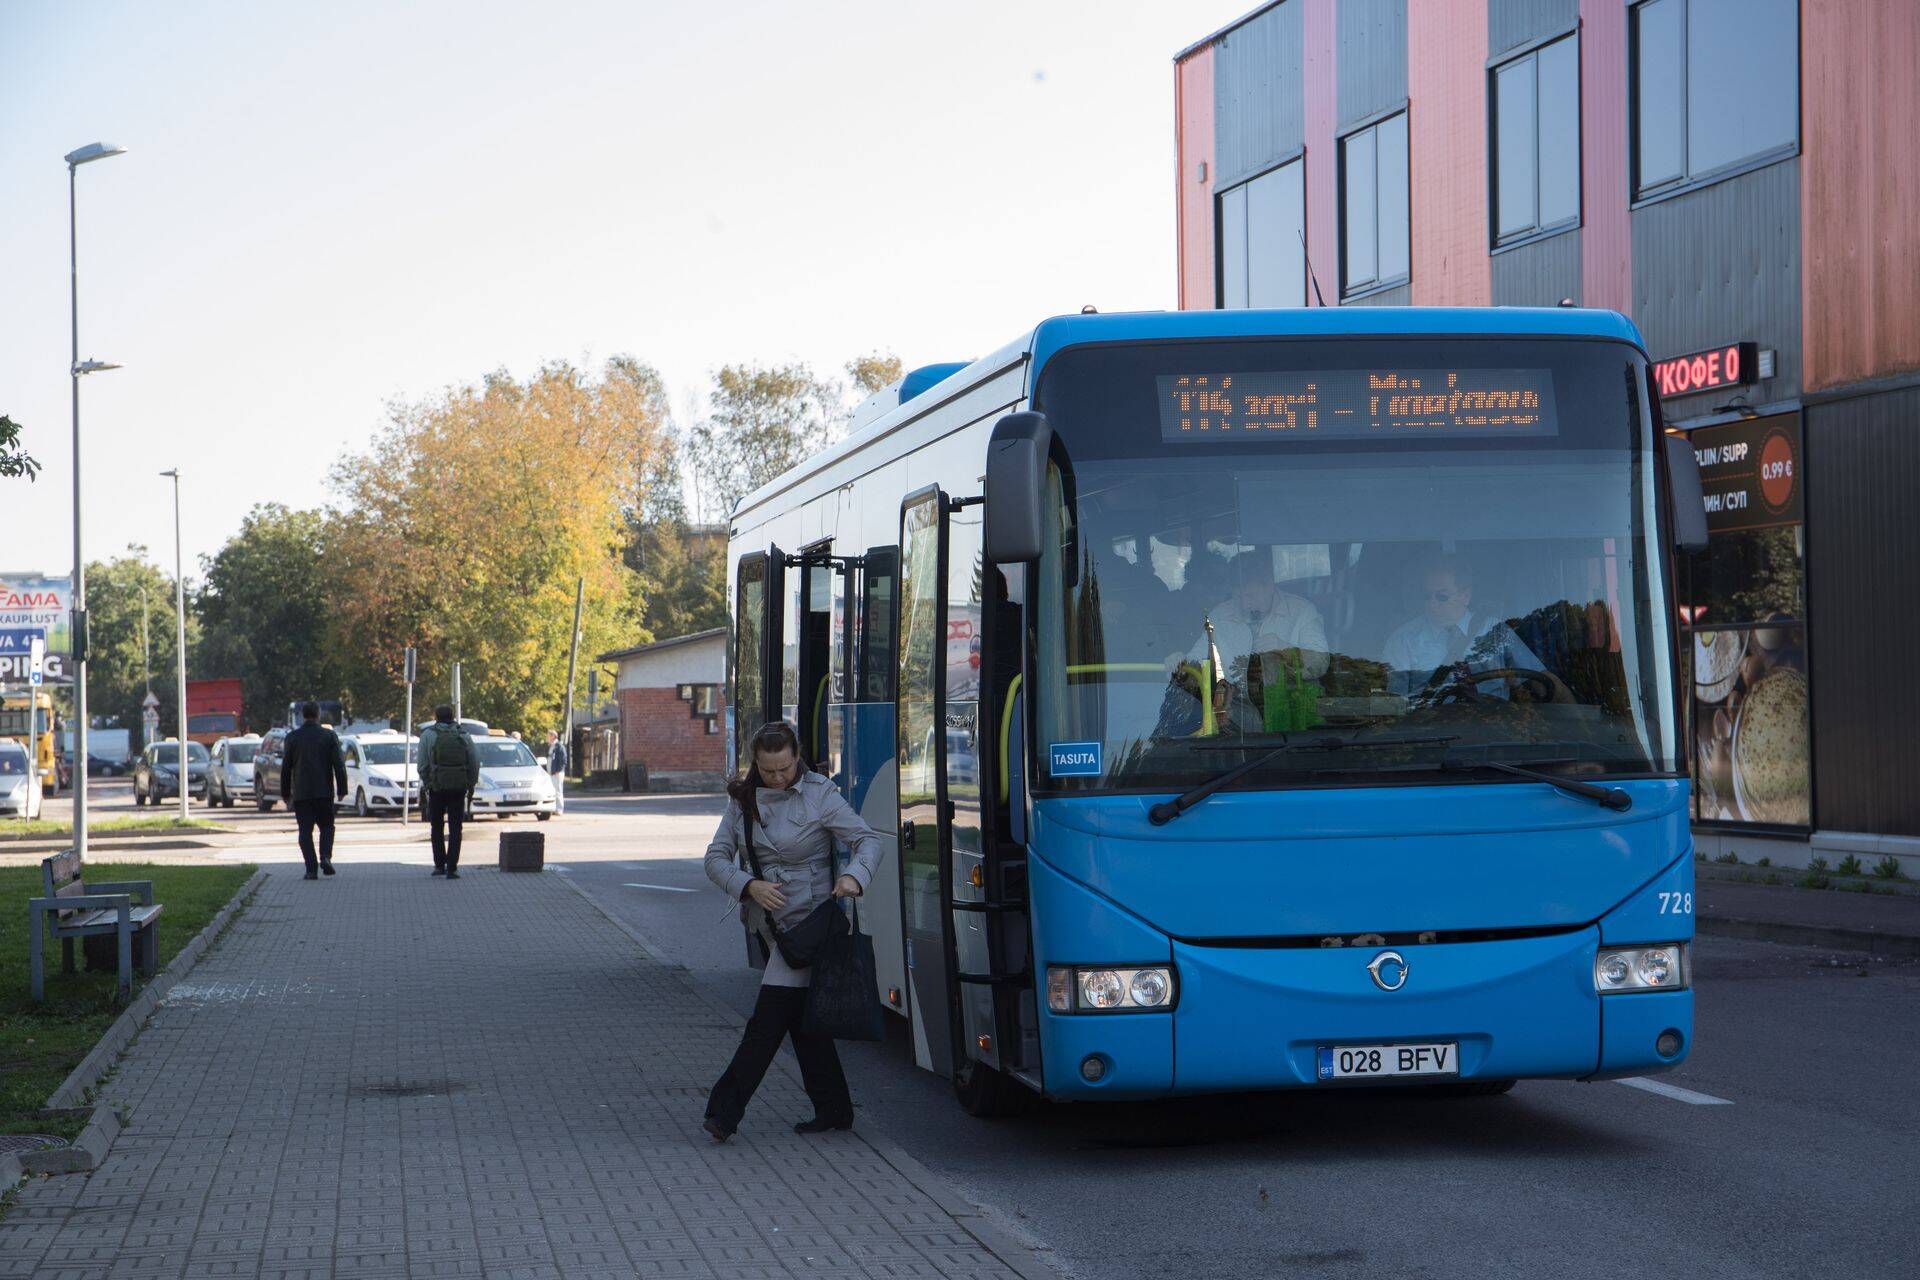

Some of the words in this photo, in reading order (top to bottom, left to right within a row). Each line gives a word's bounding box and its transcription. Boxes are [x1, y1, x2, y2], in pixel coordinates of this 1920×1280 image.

[1054, 753, 1096, 765] TASUTA
[1658, 892, 1692, 914] 728
[1340, 1050, 1382, 1073] 028
[1398, 1047, 1448, 1072] BFV
[1320, 1066, 1333, 1074] EST
